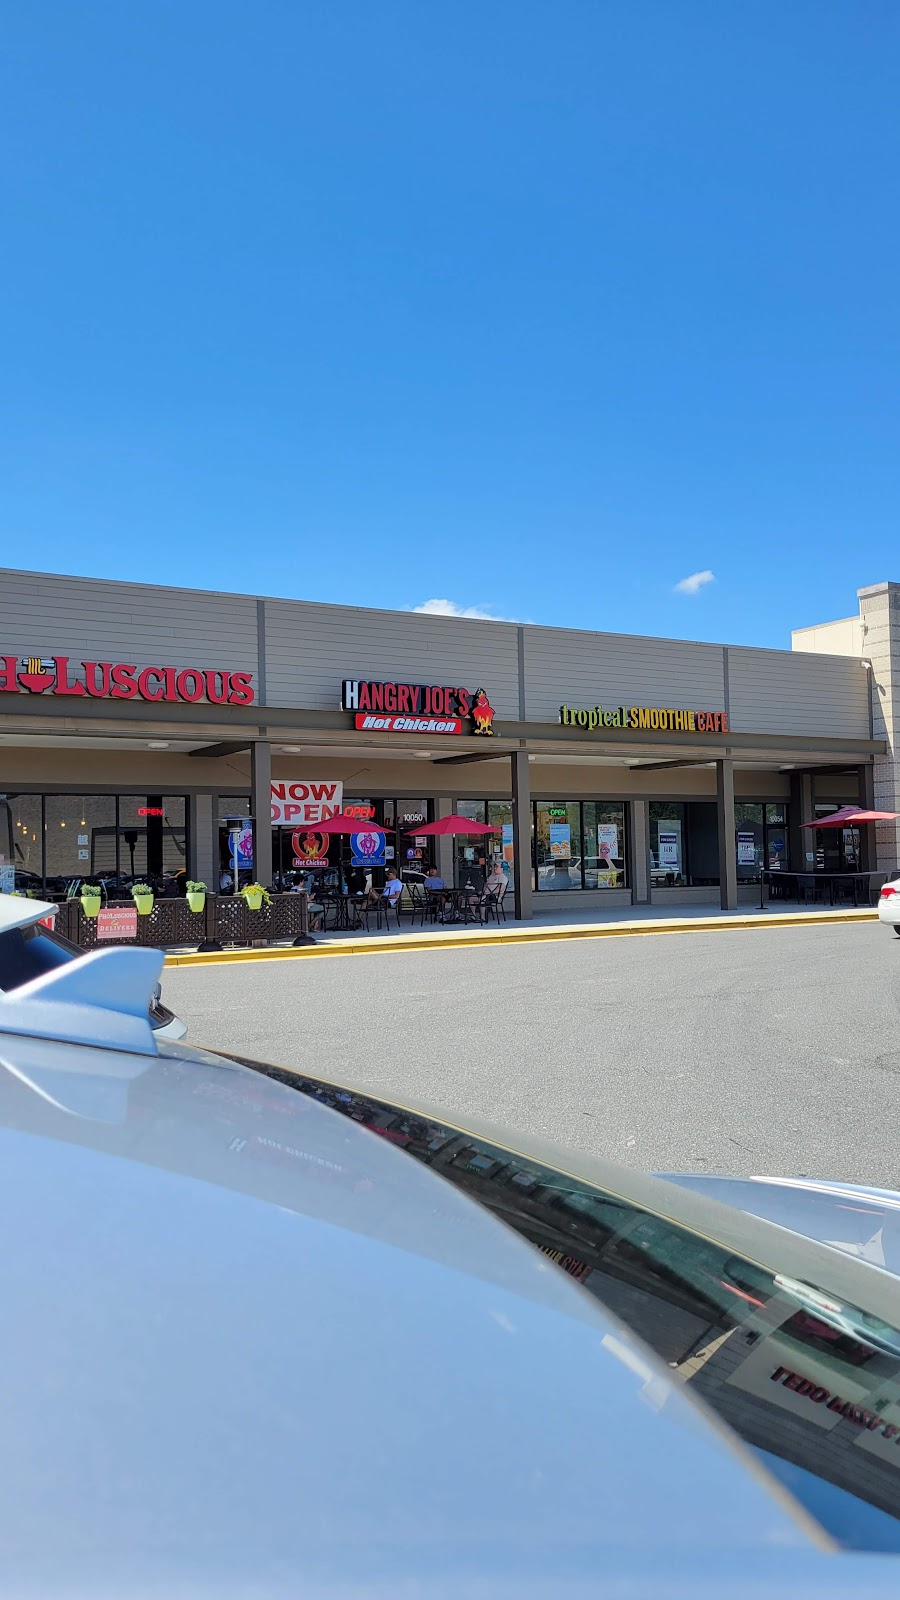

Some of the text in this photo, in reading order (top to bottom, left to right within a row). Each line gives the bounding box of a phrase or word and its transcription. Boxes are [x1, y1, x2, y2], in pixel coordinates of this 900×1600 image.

[345, 680, 470, 716] HANGRY JOE'S
[362, 716, 456, 732] Hot Chicken
[560, 704, 729, 733] tropical SMOOTHIE CAFE
[271, 783, 337, 801] NOW
[137, 807, 164, 817] OPEN
[343, 806, 376, 818] OPEN
[403, 813, 423, 822] 10050
